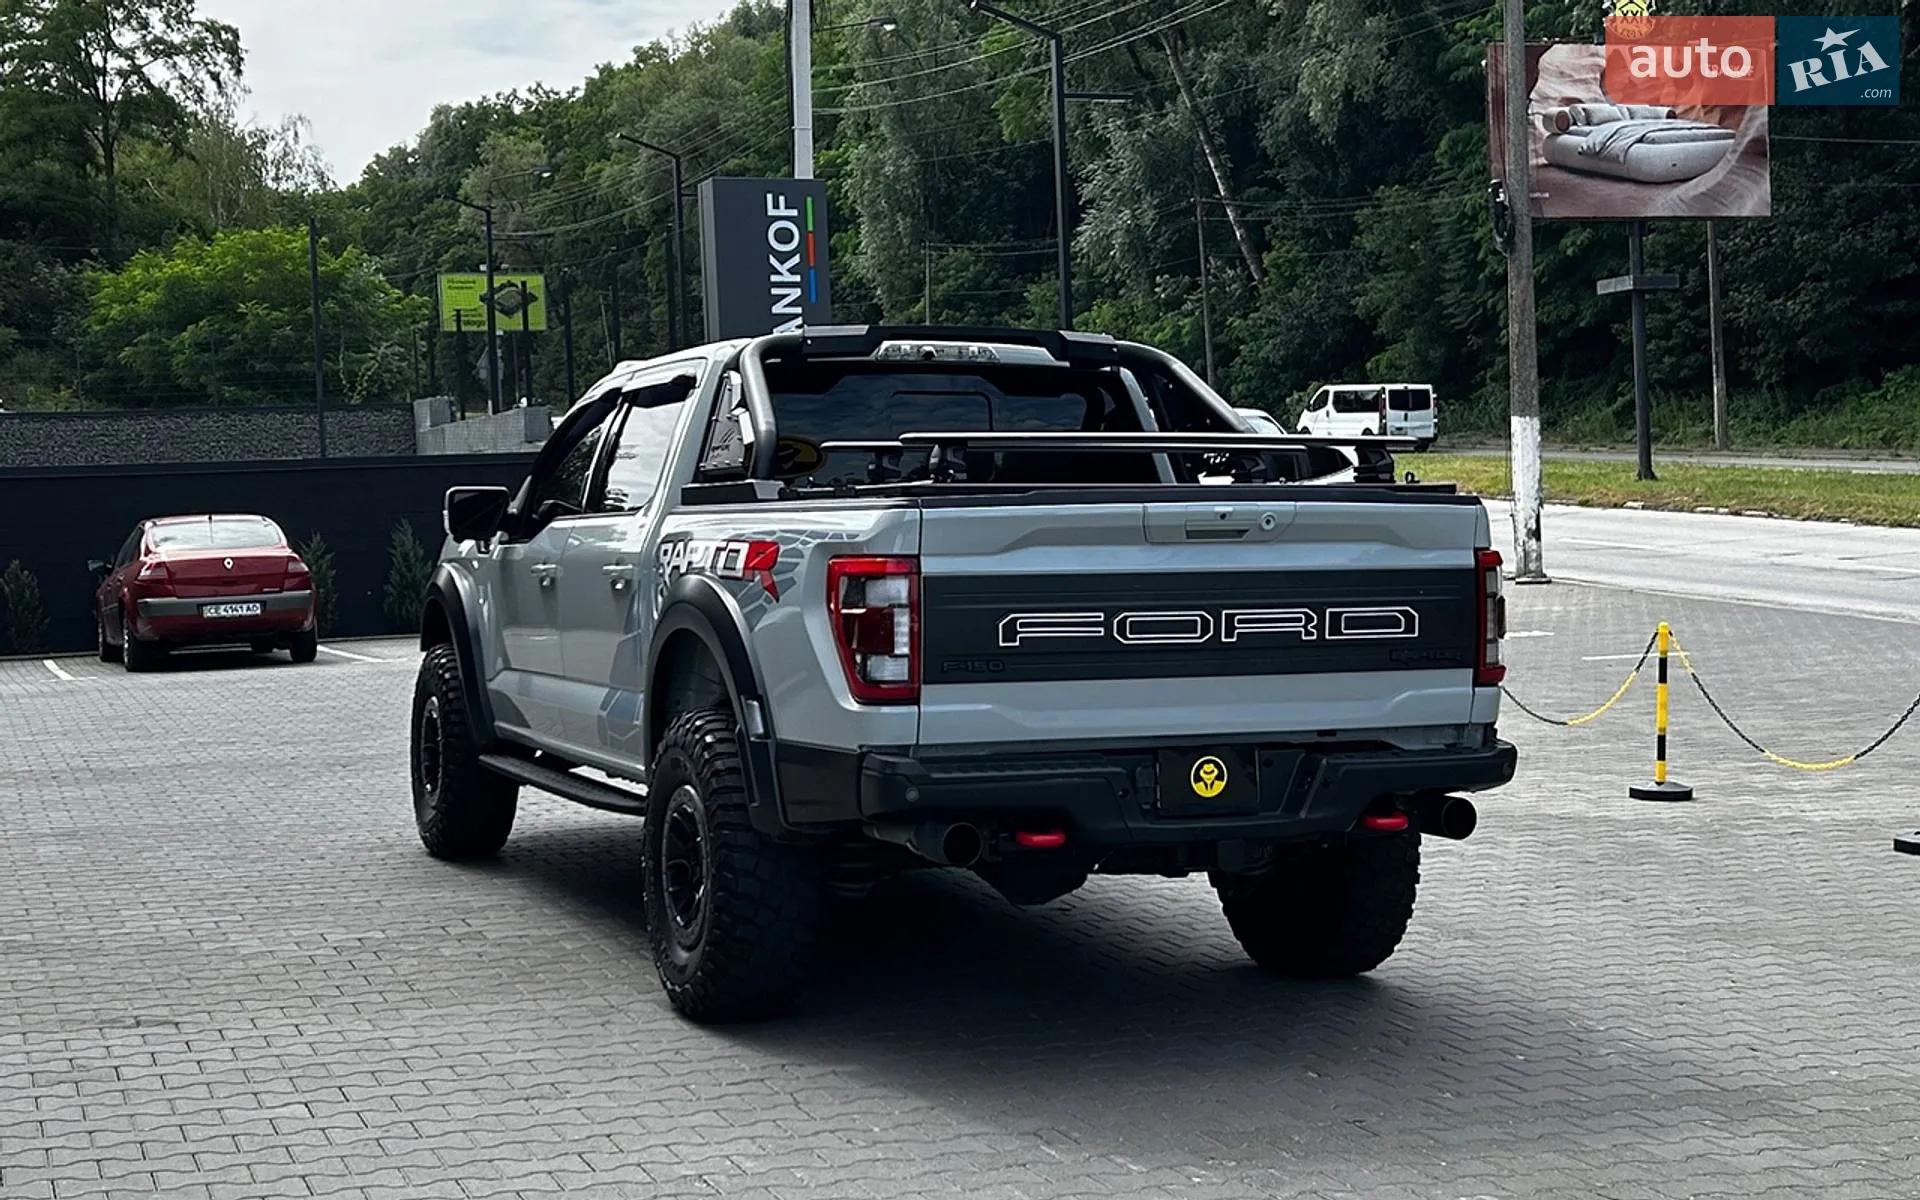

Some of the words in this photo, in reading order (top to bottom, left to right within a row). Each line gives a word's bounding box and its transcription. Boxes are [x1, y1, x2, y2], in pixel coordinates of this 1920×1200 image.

[658, 538, 781, 603] RAPTOR
[999, 606, 1419, 647] FORD
[941, 660, 1006, 673] F-150
